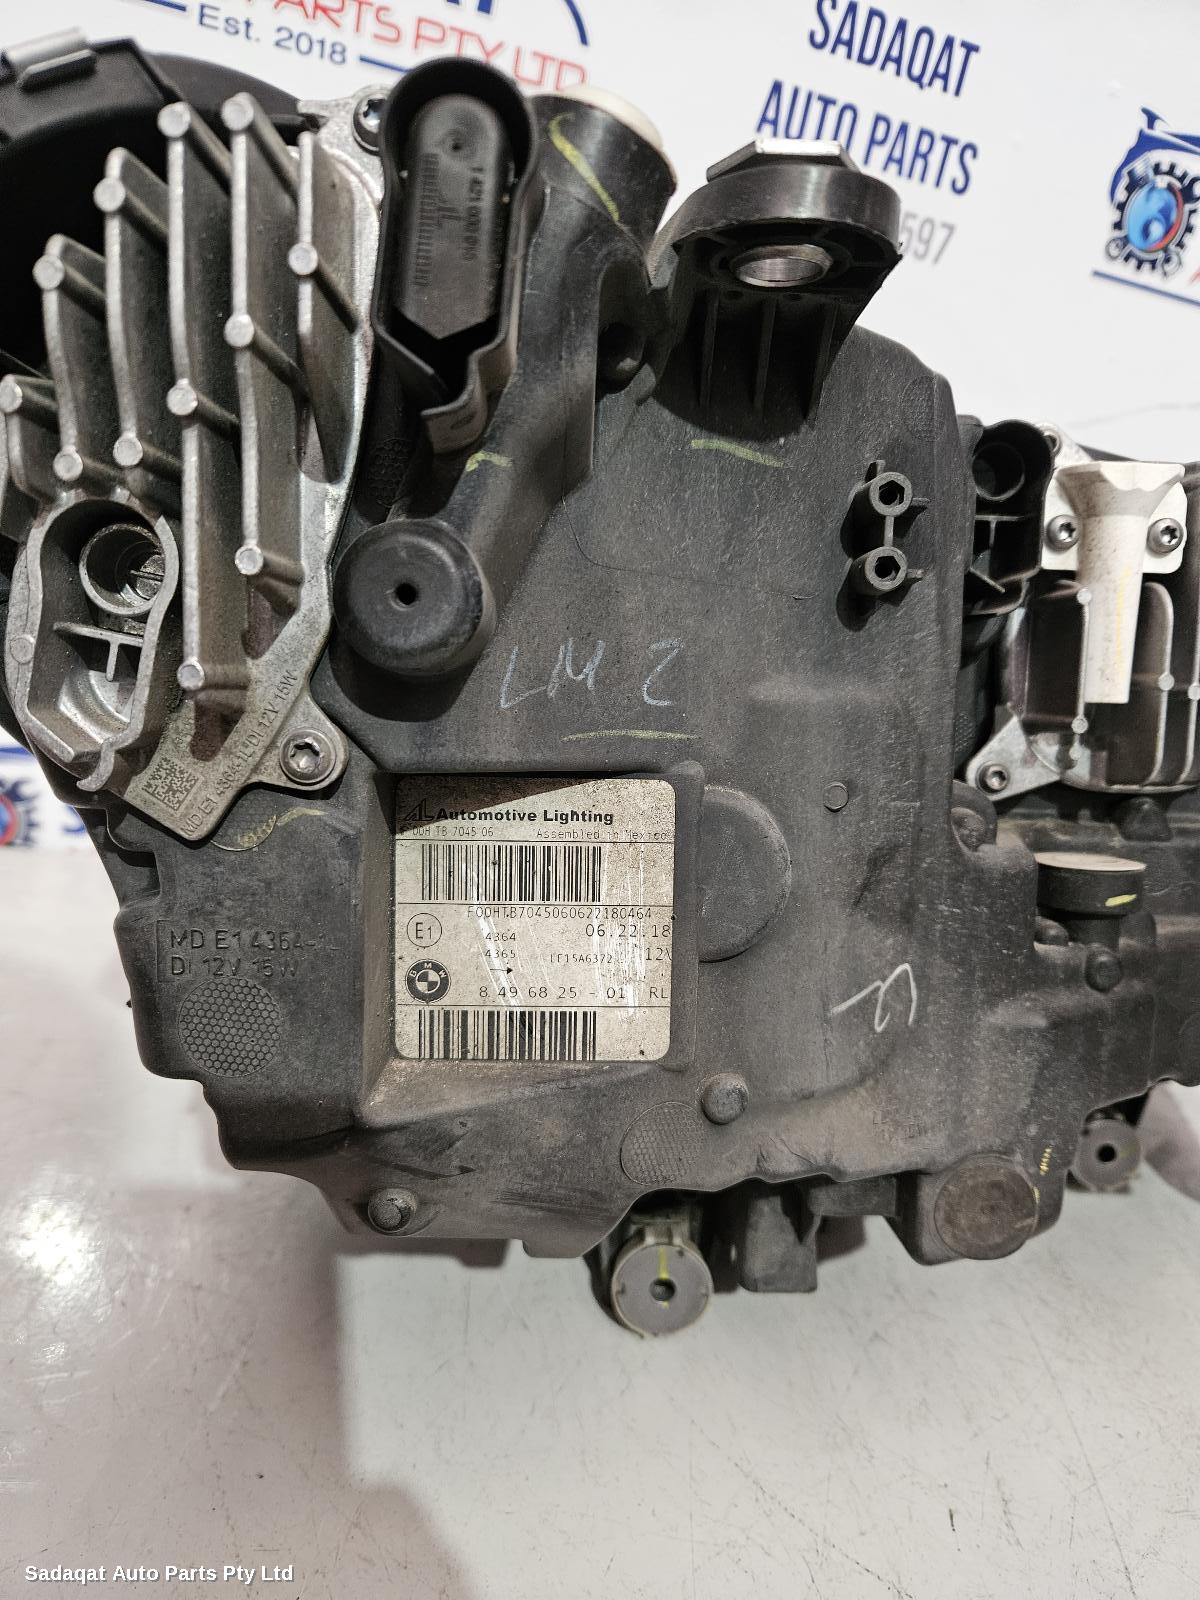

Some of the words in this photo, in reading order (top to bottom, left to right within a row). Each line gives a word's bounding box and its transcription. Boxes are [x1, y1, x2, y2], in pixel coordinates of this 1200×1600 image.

[199, 4, 260, 43] Est.
[273, 26, 347, 65] 2018
[246, 0, 401, 44] ARTS
[414, 15, 506, 63] PTY
[512, 47, 587, 91] LTD
[808, 0, 981, 97] SADAQAT
[863, 112, 979, 195] PARTS
[436, 807, 537, 821] Automotive
[543, 809, 614, 825] Lighting
[415, 921, 432, 940] E1
[485, 932, 516, 942] 4364
[585, 923, 671, 938] 06.22.18
[485, 949, 516, 959] 4365
[649, 986, 669, 999] RL
